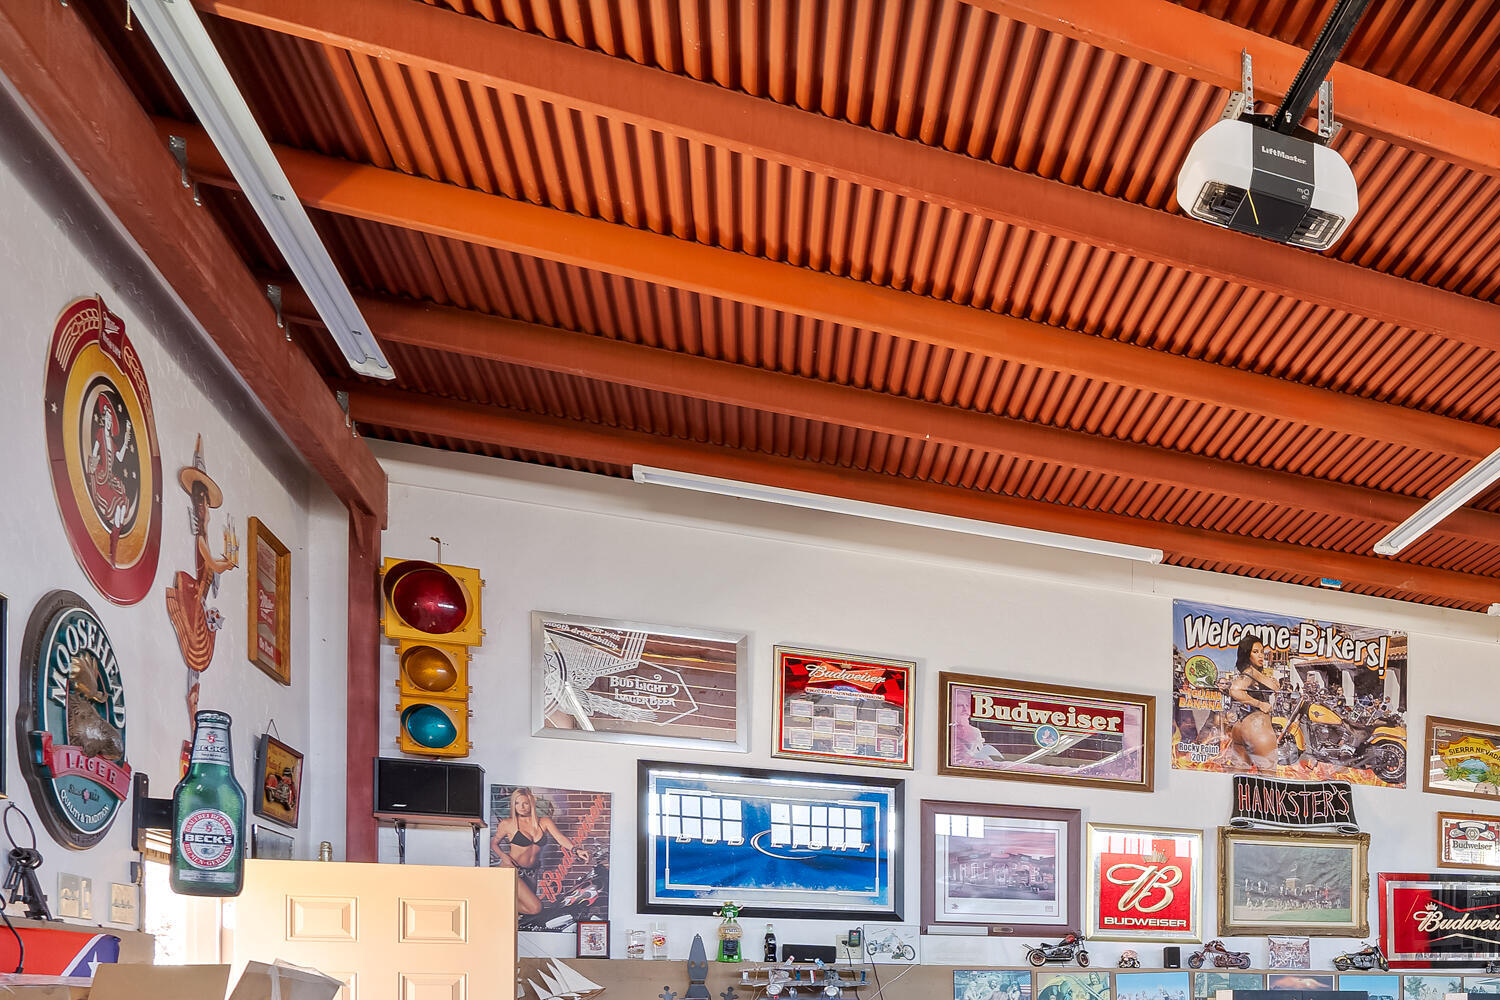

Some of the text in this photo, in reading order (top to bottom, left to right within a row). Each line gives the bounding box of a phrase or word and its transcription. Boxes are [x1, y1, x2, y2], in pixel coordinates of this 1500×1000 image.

[1261, 145, 1306, 165] LiftMaster
[1184, 614, 1391, 677] Welcome Bikers!
[51, 618, 125, 729] MOOSEHEAD
[805, 664, 886, 684] Budweiser
[610, 676, 669, 694] BUD LIGHT
[972, 694, 1121, 732] Budweiser
[1178, 697, 1224, 711] BANANA
[1178, 742, 1219, 754] Rocky Point
[1191, 753, 1208, 762] 2017
[1448, 746, 1475, 756] SIERRA
[66, 752, 117, 785] LAGER
[60, 789, 81, 822] QUALITY
[85, 805, 110, 825] TRADITION
[1238, 783, 1350, 818] HANKSTER'S
[185, 834, 233, 845] BECK'S
[674, 832, 871, 854] BUD LIGHT
[1452, 838, 1494, 851] Budweiser
[1107, 863, 1182, 914] B
[1104, 915, 1188, 928] BUDWEISER
